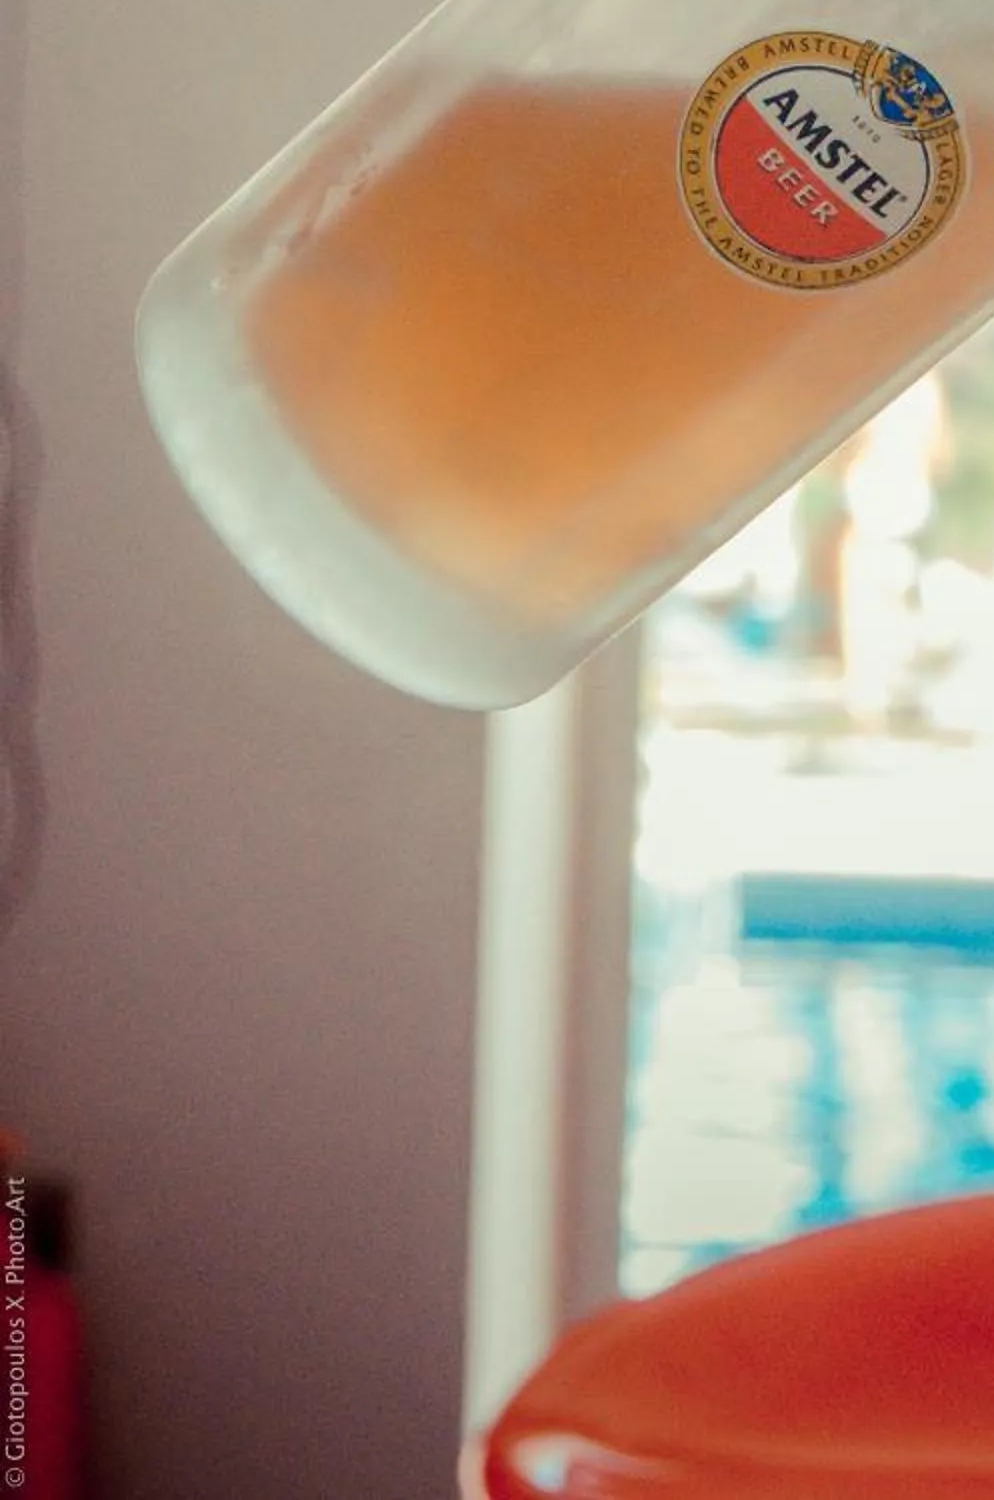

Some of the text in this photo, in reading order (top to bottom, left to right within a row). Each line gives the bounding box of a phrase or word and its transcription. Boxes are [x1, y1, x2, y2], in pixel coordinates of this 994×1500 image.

[686, 55, 933, 281] BREWED TO THE AMSTEL TRADITION
[757, 147, 840, 228] BEER
[762, 88, 888, 219] AMSTEL
[763, 37, 953, 205] AMSTEL LAGER
